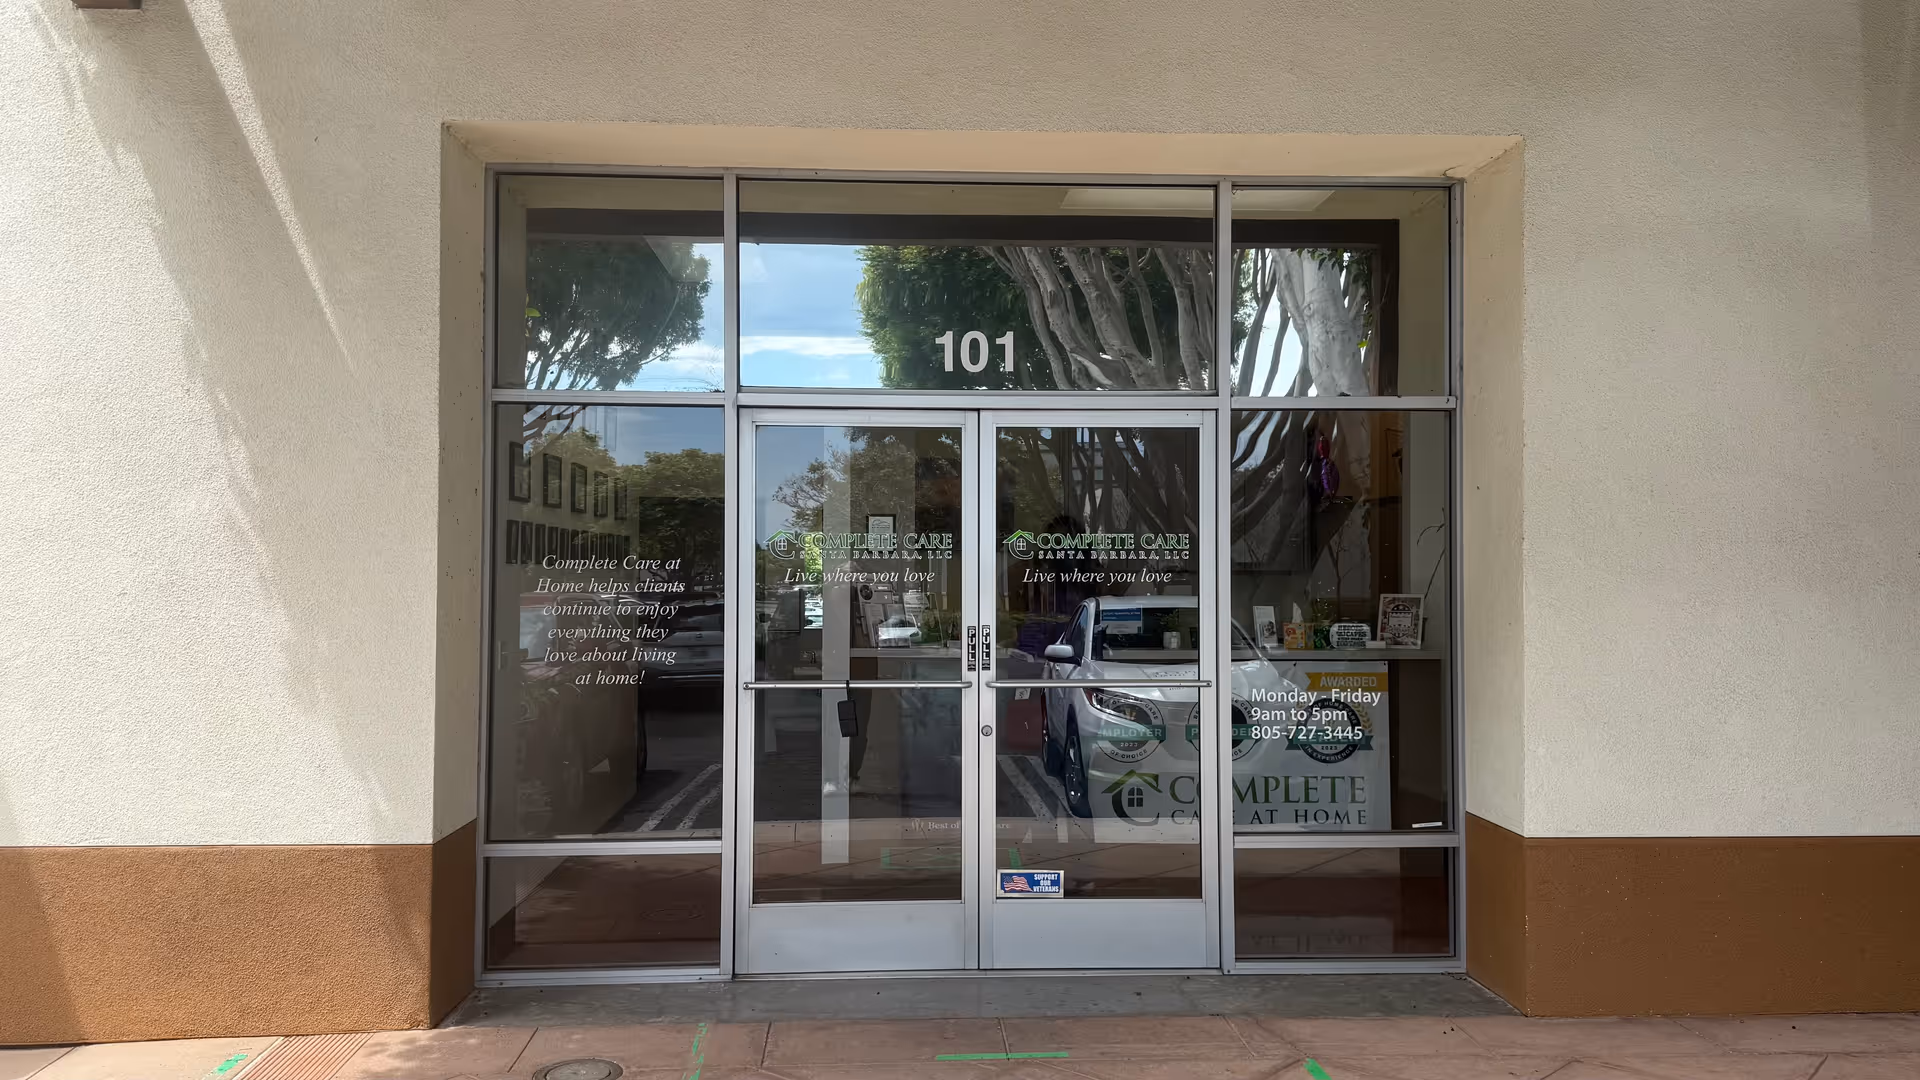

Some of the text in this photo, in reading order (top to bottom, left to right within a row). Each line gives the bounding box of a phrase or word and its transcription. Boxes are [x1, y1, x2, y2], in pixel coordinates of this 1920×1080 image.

[935, 331, 1014, 372] 101
[799, 532, 953, 549] COMPLETE CARE
[1037, 533, 1190, 550] COMPLETE CARE
[542, 554, 682, 573] Complete Care at
[800, 551, 953, 560] SANTA BARBARA, LLC
[1038, 551, 1190, 561] SANTA BARBARA, LLC
[785, 568, 935, 586] Live where you love
[1022, 568, 1172, 586] Live where you love
[535, 578, 686, 596] Home helps clients
[543, 602, 679, 619] continue to enjoy
[547, 624, 669, 642] everything they
[968, 629, 976, 661] PULL
[982, 628, 990, 660] PULL
[544, 648, 677, 665] love about living
[575, 670, 646, 685] at home!
[1320, 676, 1377, 687] AWARDED
[1251, 688, 1318, 706] Monday
[1331, 688, 1382, 706] Friday
[1251, 707, 1286, 721] 9am
[1290, 708, 1307, 721] to
[1312, 707, 1348, 725] 5pm
[1251, 726, 1363, 740] 805-727-3445
[1110, 749, 1148, 760] OF CHOICE
[1169, 775, 1367, 805] CMPLETE
[1250, 809, 1279, 825] AT
[1294, 809, 1367, 825] HOME
[1034, 873, 1058, 881] SUPPORT
[1033, 885, 1059, 893] VETERANS
